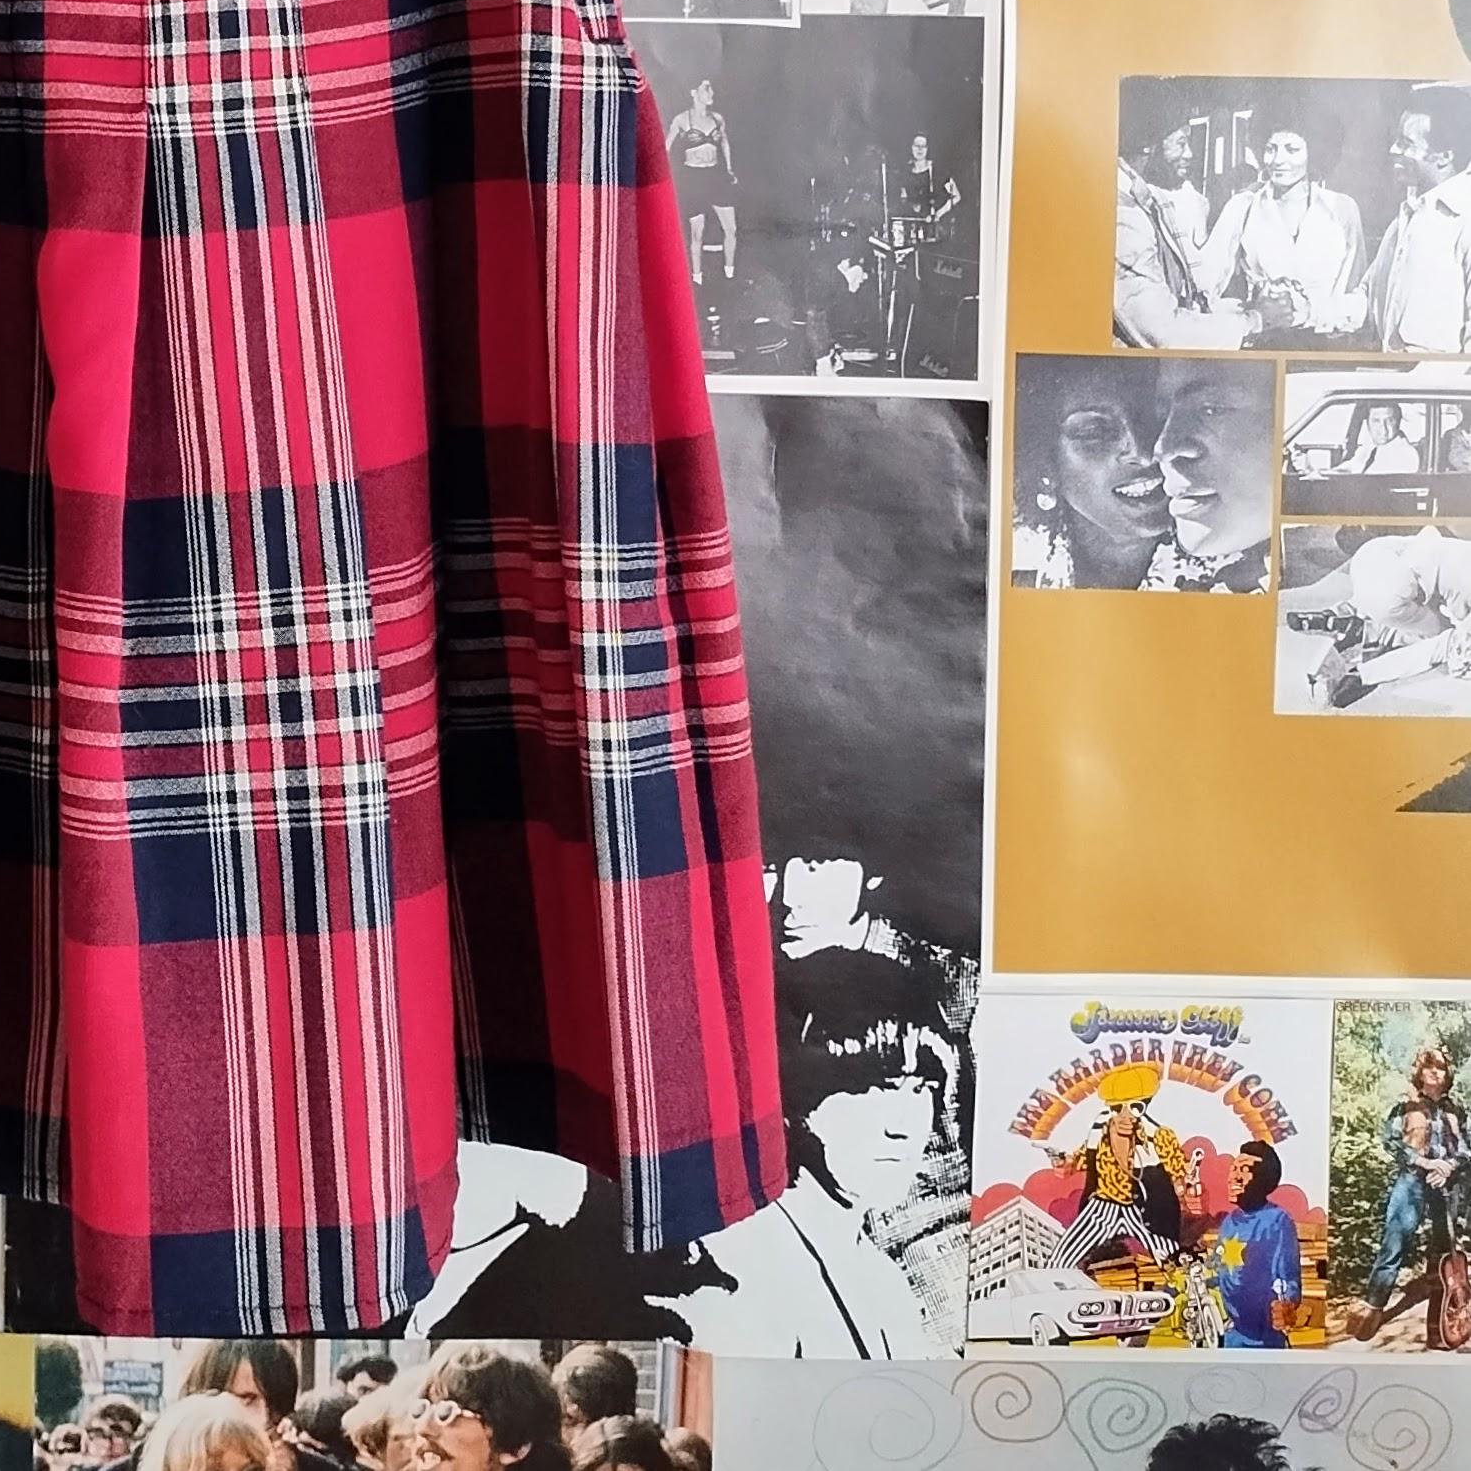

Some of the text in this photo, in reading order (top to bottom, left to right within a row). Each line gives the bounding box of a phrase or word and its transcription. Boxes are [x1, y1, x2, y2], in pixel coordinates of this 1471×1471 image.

[1180, 1003, 1244, 1048] Cliff
[1335, 1001, 1412, 1013] GREEN RIVER
[1048, 1037, 1165, 1097] HARDER
[1235, 1073, 1300, 1144] COME
